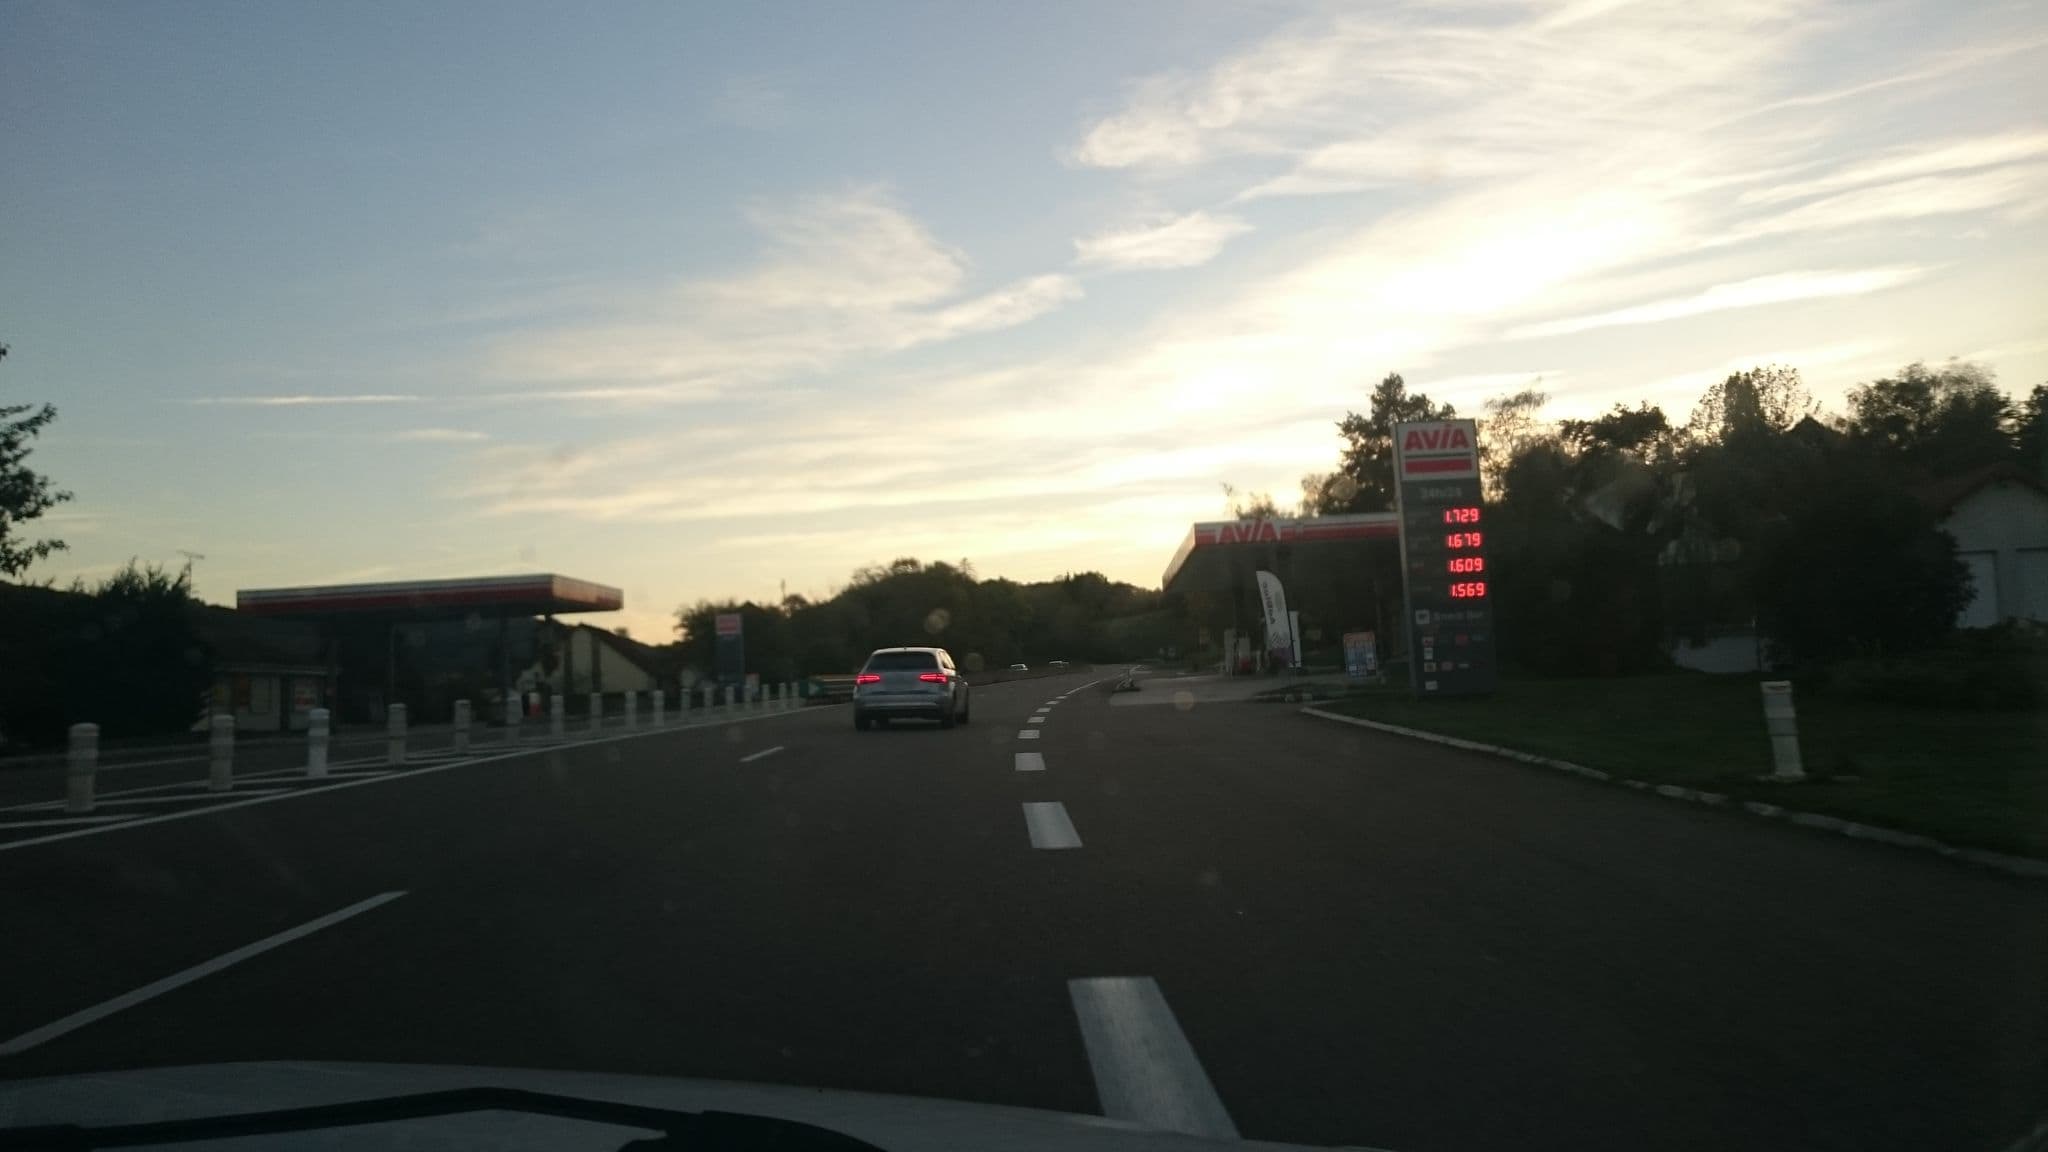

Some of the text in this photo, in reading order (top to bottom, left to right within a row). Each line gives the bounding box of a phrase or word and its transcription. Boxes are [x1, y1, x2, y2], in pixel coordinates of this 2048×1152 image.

[1404, 424, 1471, 451] AVIA
[1444, 508, 1480, 523] 1.729
[1218, 519, 1279, 545] AVIA
[1447, 532, 1482, 548] 1.679
[1449, 557, 1484, 573] 1.609
[1451, 582, 1486, 598] 1.569
